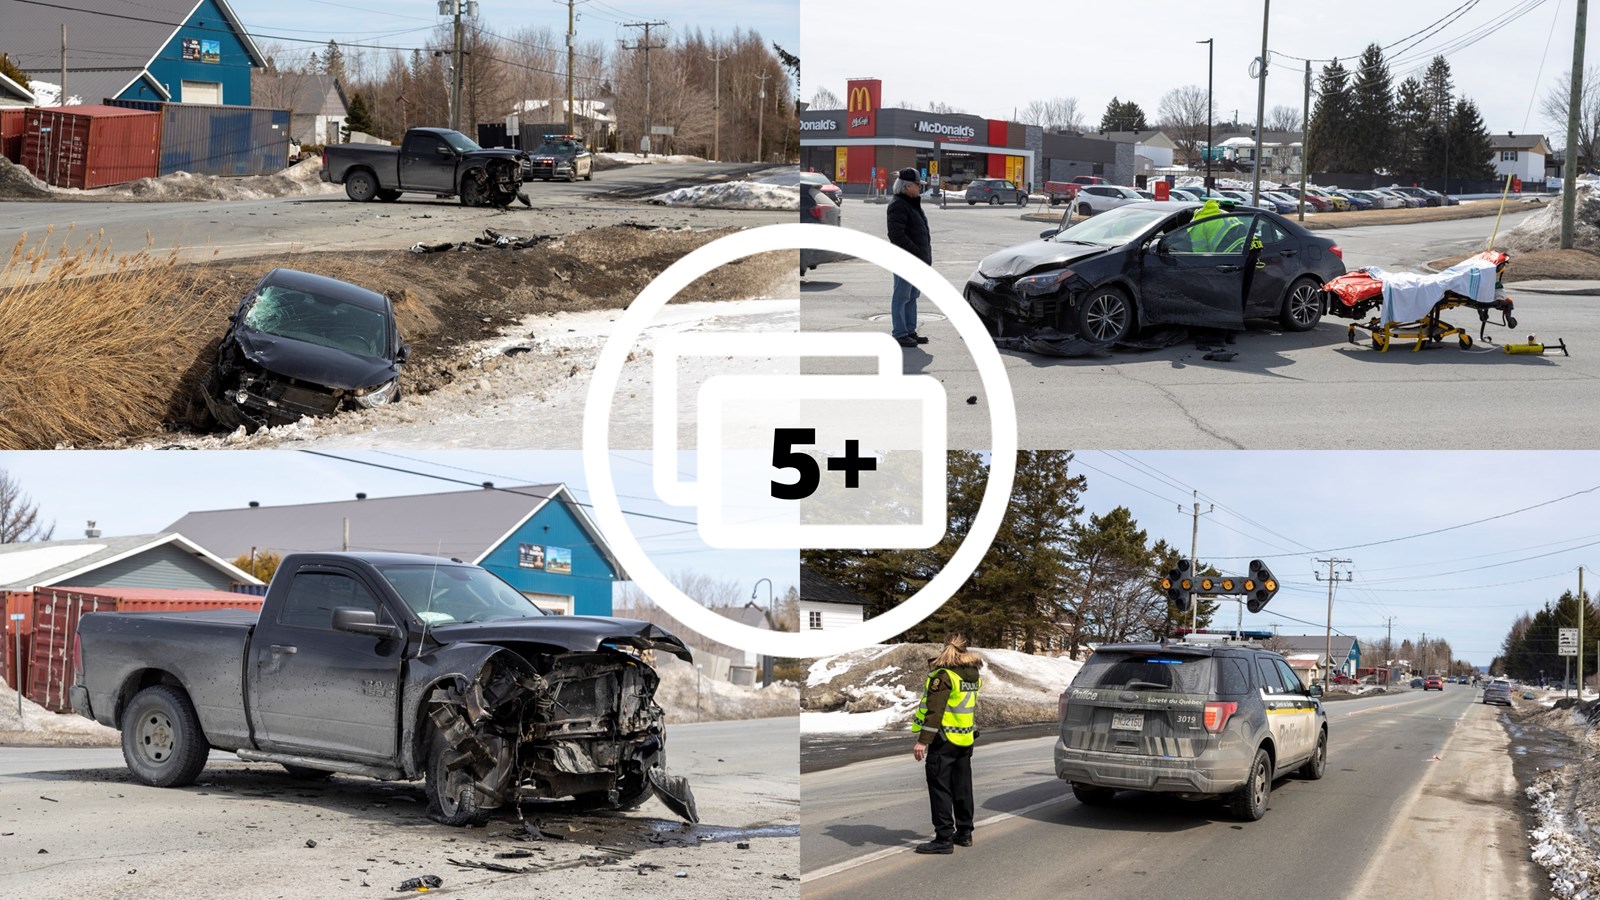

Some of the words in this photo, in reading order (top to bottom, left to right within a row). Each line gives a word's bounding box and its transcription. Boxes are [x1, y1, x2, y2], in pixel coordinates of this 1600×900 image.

[918, 120, 975, 137] McDonald's
[1071, 689, 1098, 700] Police
[1176, 715, 1197, 723] 3019
